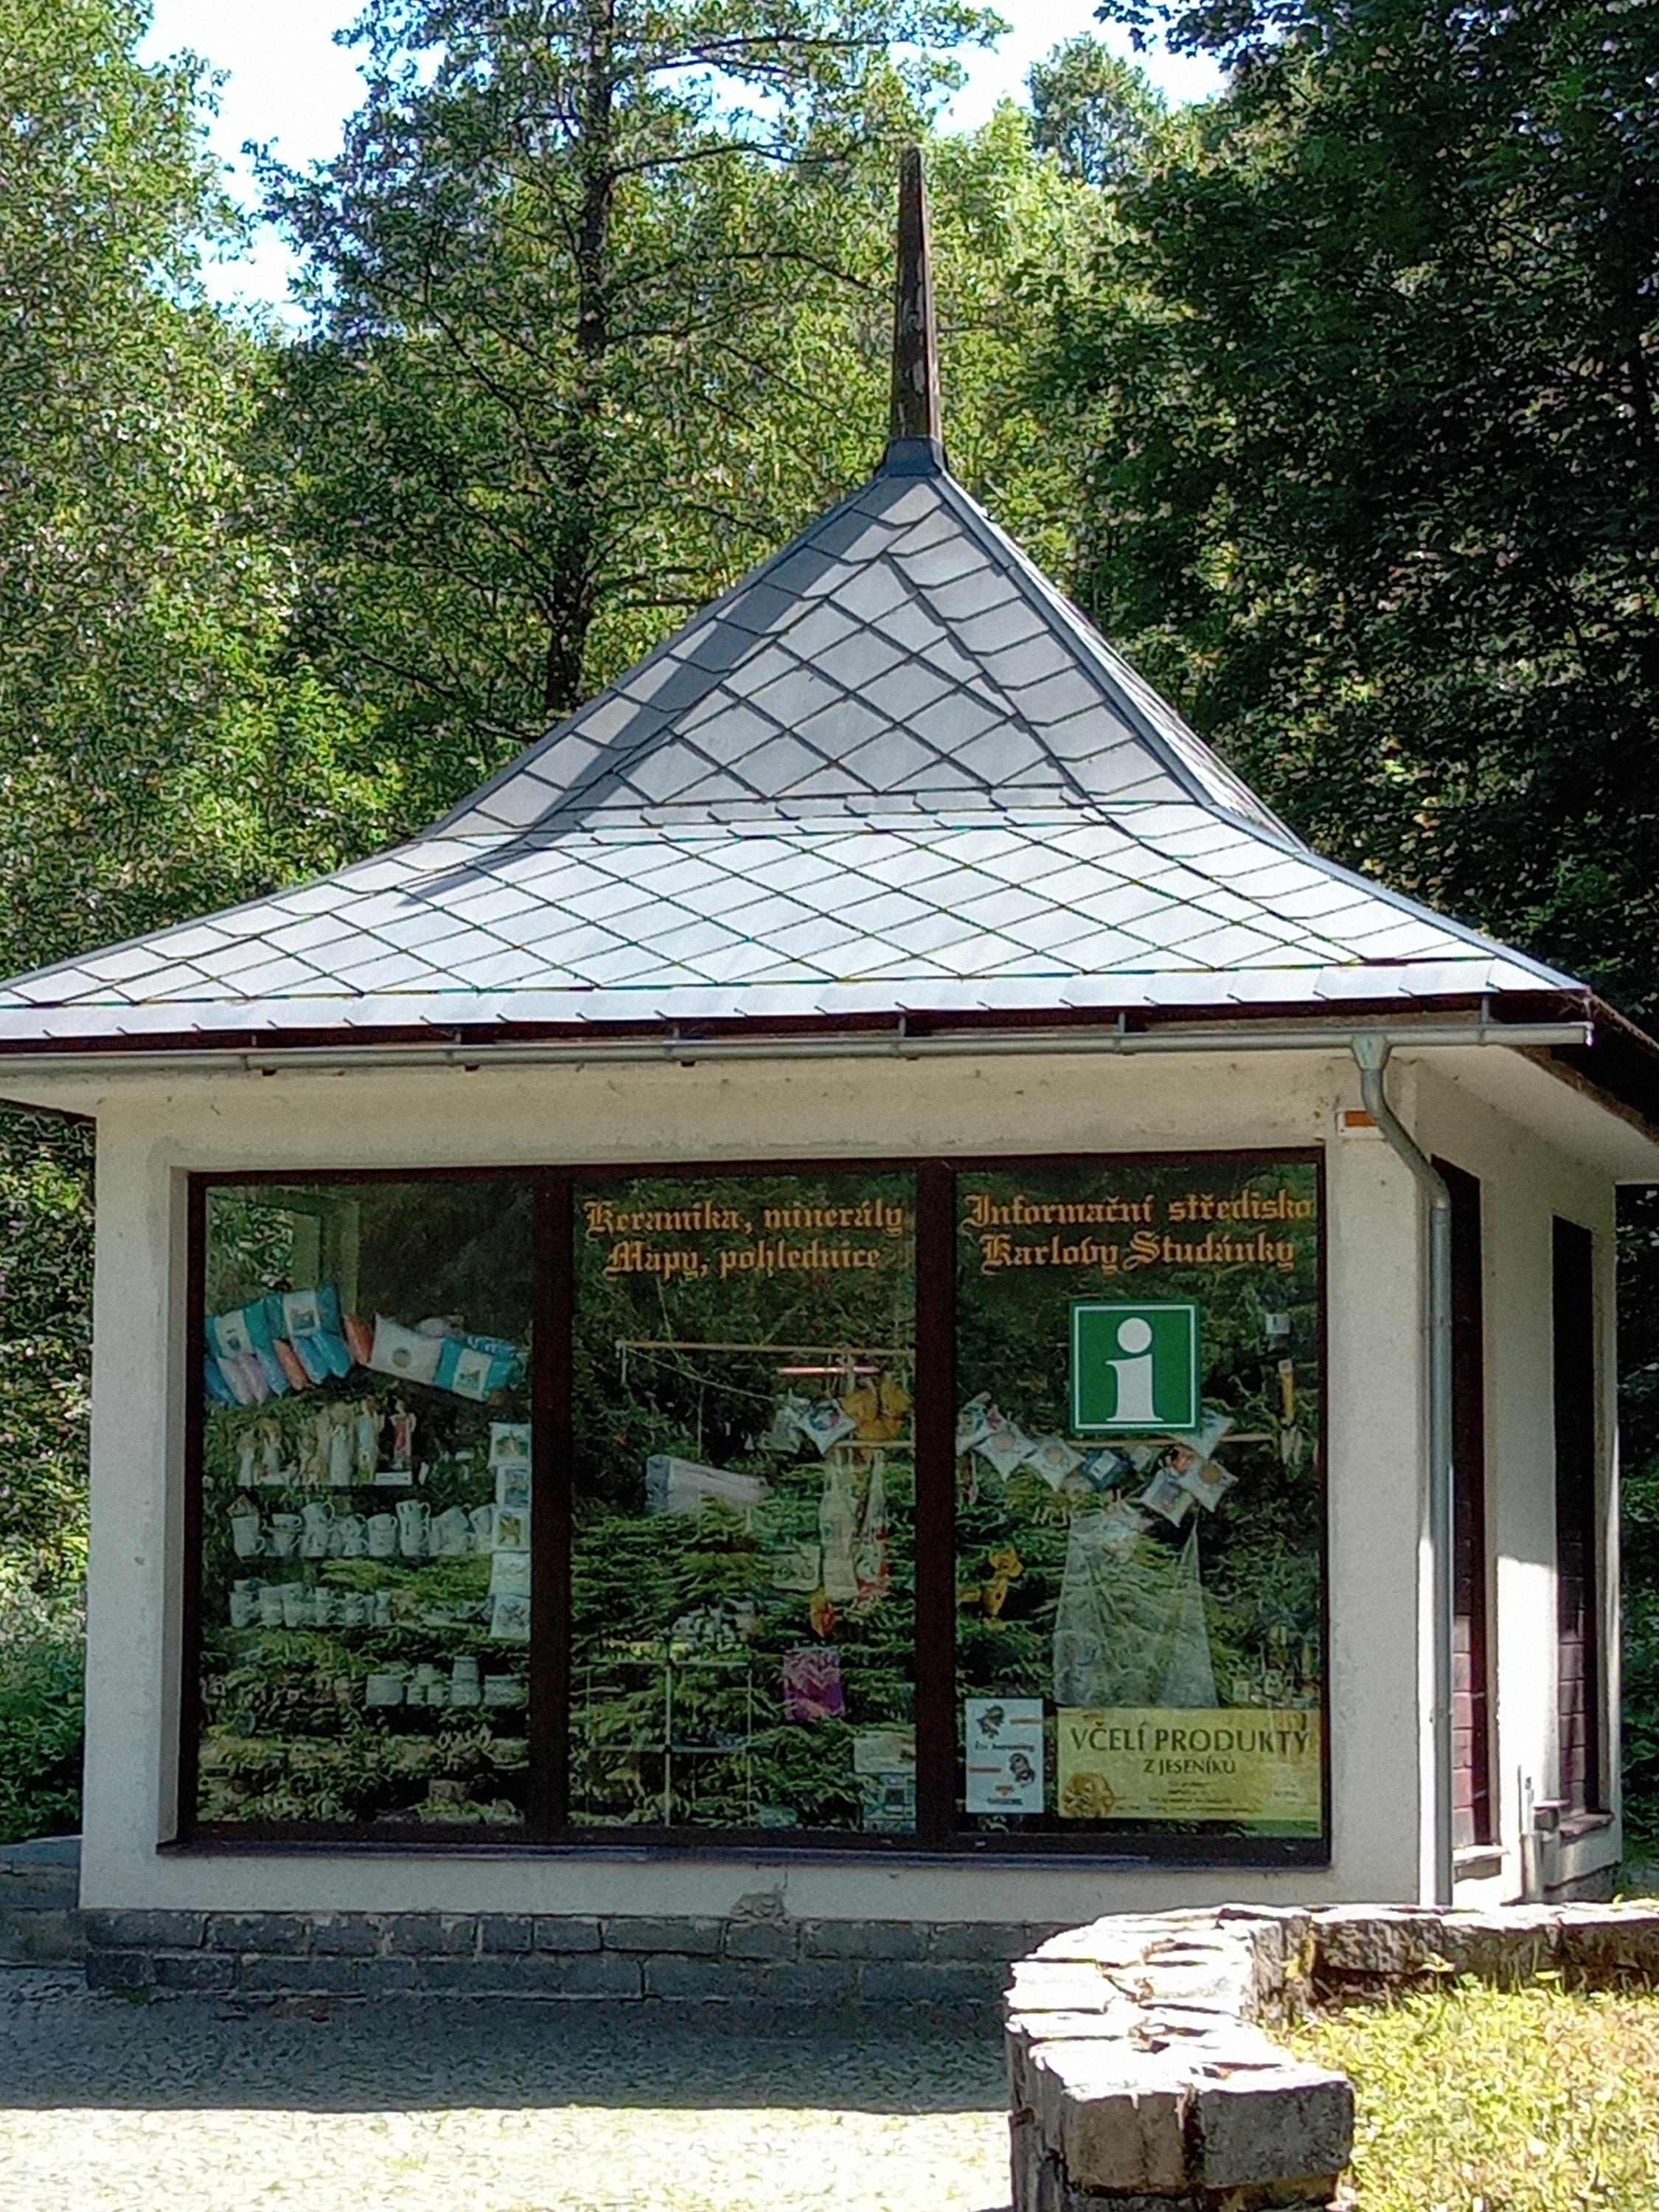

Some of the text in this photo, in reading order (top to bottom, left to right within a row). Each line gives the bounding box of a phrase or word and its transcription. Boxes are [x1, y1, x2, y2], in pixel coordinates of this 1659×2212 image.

[584, 1198, 905, 1239] Keramika, minerály
[961, 1189, 1313, 1235] Informační středisko
[602, 1238, 882, 1280] Mapy, pohlednice
[979, 1228, 1295, 1276] Karlovy Studánky
[1070, 1721, 1310, 1754] VČELÍ PRODUKTY
[1143, 1759, 1155, 1773] Z
